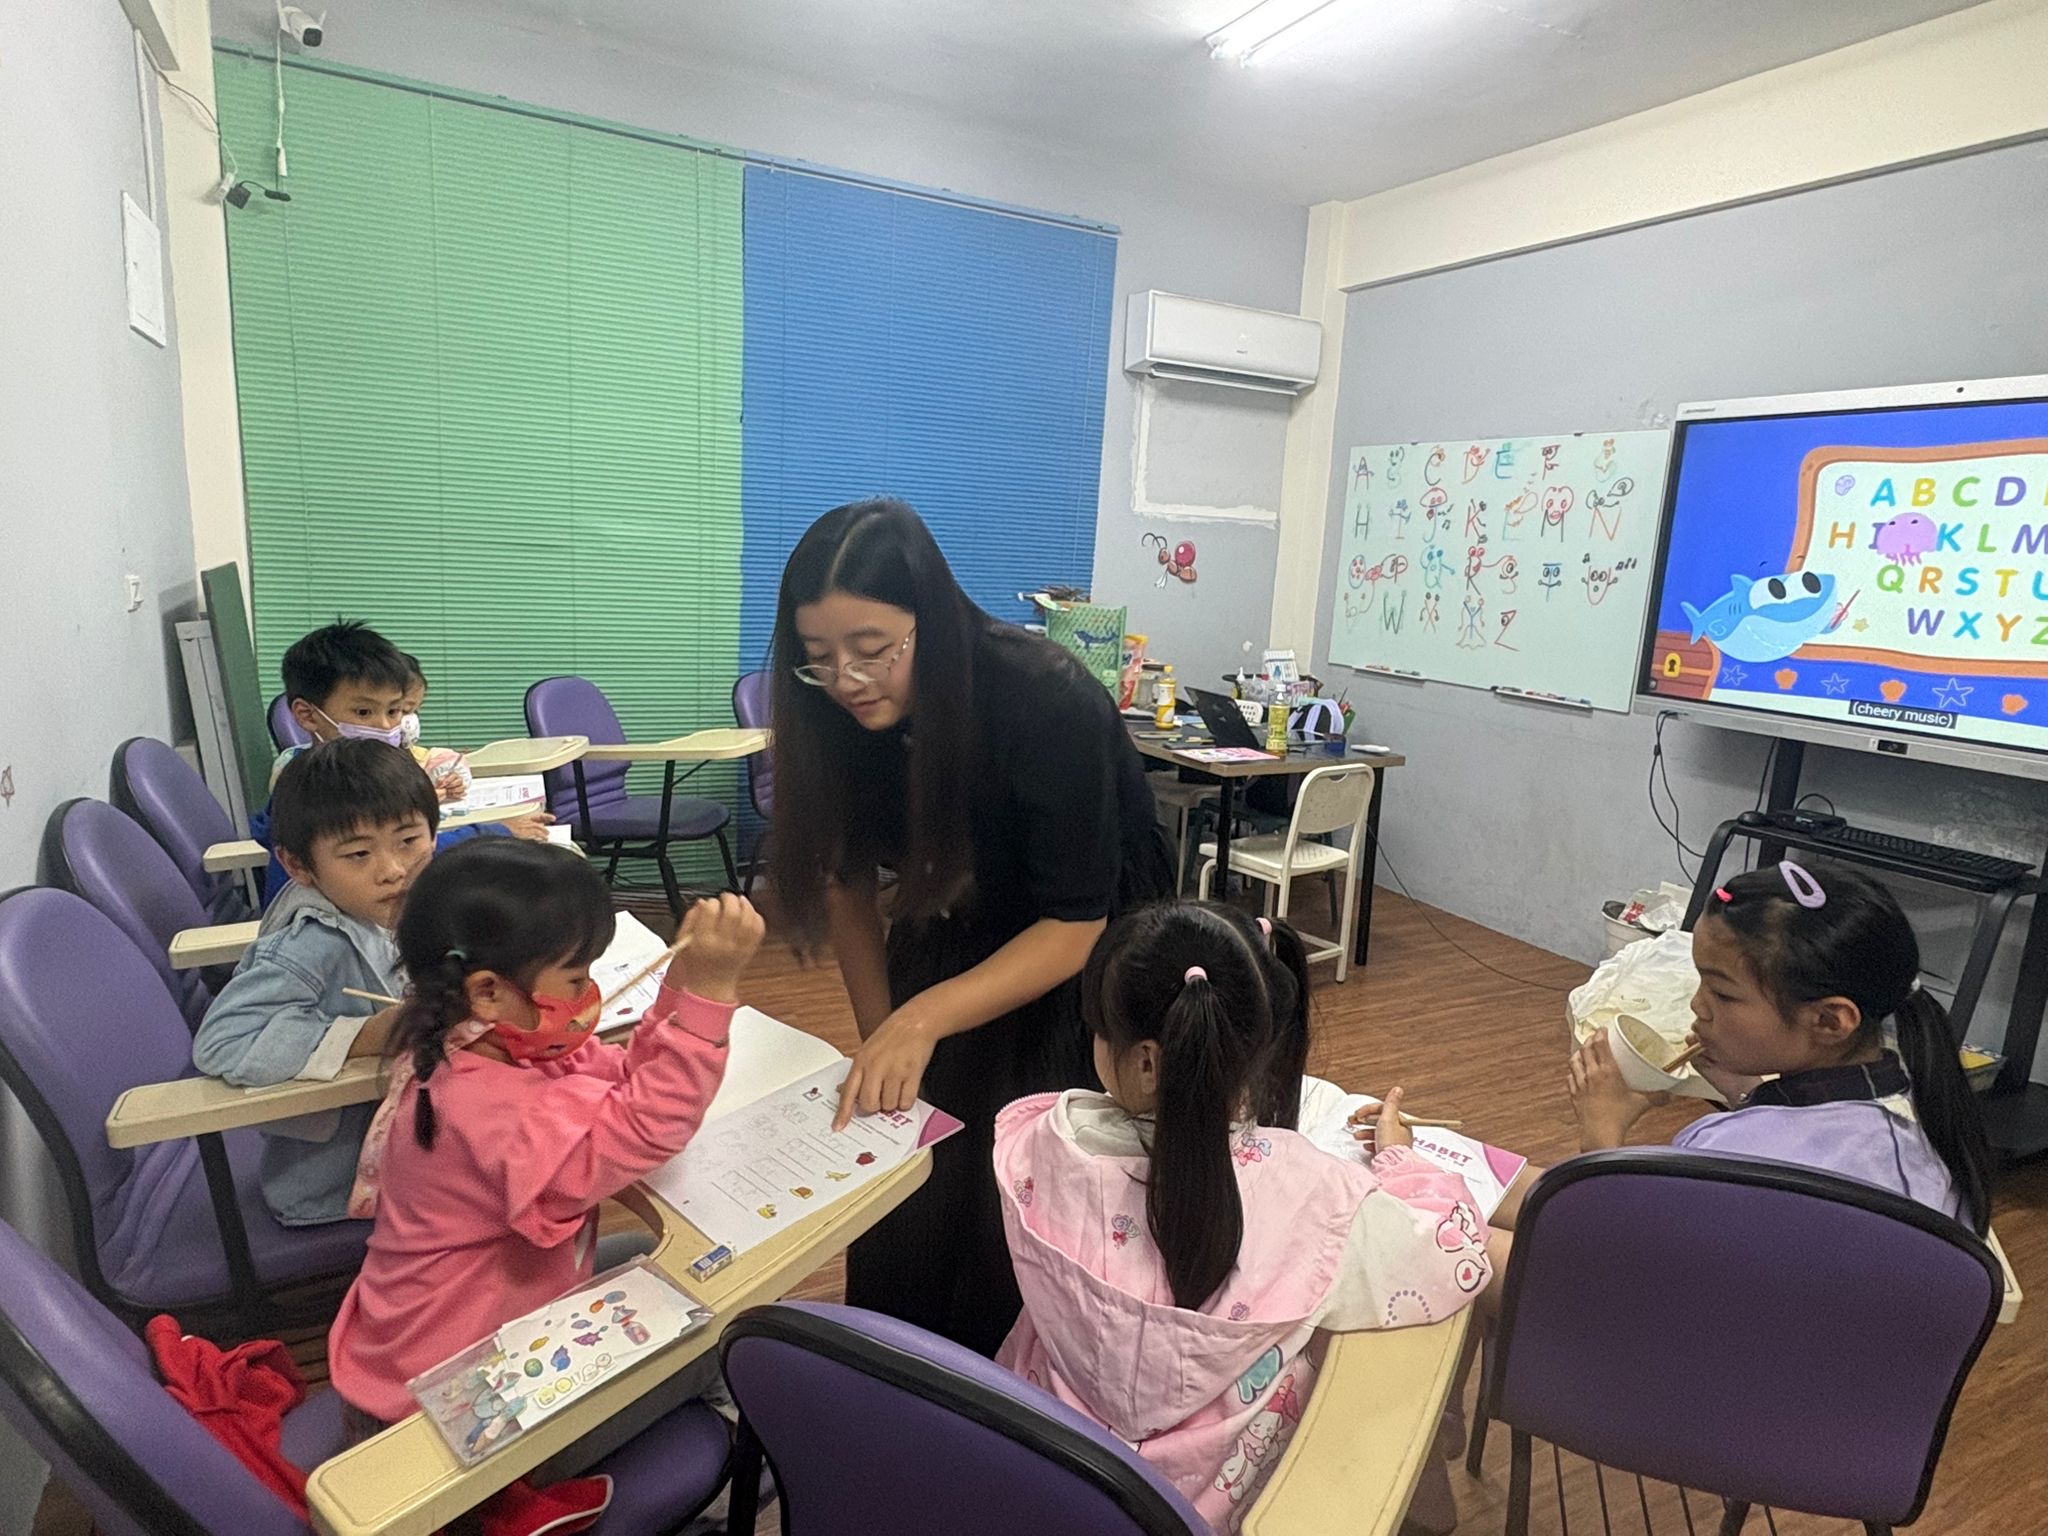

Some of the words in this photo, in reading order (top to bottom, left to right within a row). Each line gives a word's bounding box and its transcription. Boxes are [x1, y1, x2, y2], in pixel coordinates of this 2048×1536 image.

[1354, 456, 1371, 491] A
[1424, 451, 1444, 486] C
[1495, 448, 1514, 480] E
[1870, 478, 1896, 507] A
[1911, 477, 1937, 507] B
[1952, 476, 1981, 507] C
[1994, 476, 2027, 507] D
[1355, 504, 1370, 541] H
[1465, 501, 1487, 543] K
[1589, 505, 1623, 542] N
[1828, 521, 1856, 550] H
[1935, 522, 1964, 552] K
[1977, 523, 1997, 553] L
[1543, 563, 1563, 601] T
[1876, 564, 1905, 594] Q
[1918, 566, 1943, 594] R
[1954, 567, 1980, 596] S
[1994, 568, 2019, 598] T
[1383, 590, 1407, 635] W
[1907, 607, 1945, 636] W
[1953, 611, 1983, 640] X
[1995, 613, 2023, 642] Y
[1852, 701, 1902, 721] (cheery
[1904, 710, 1953, 728] music)
